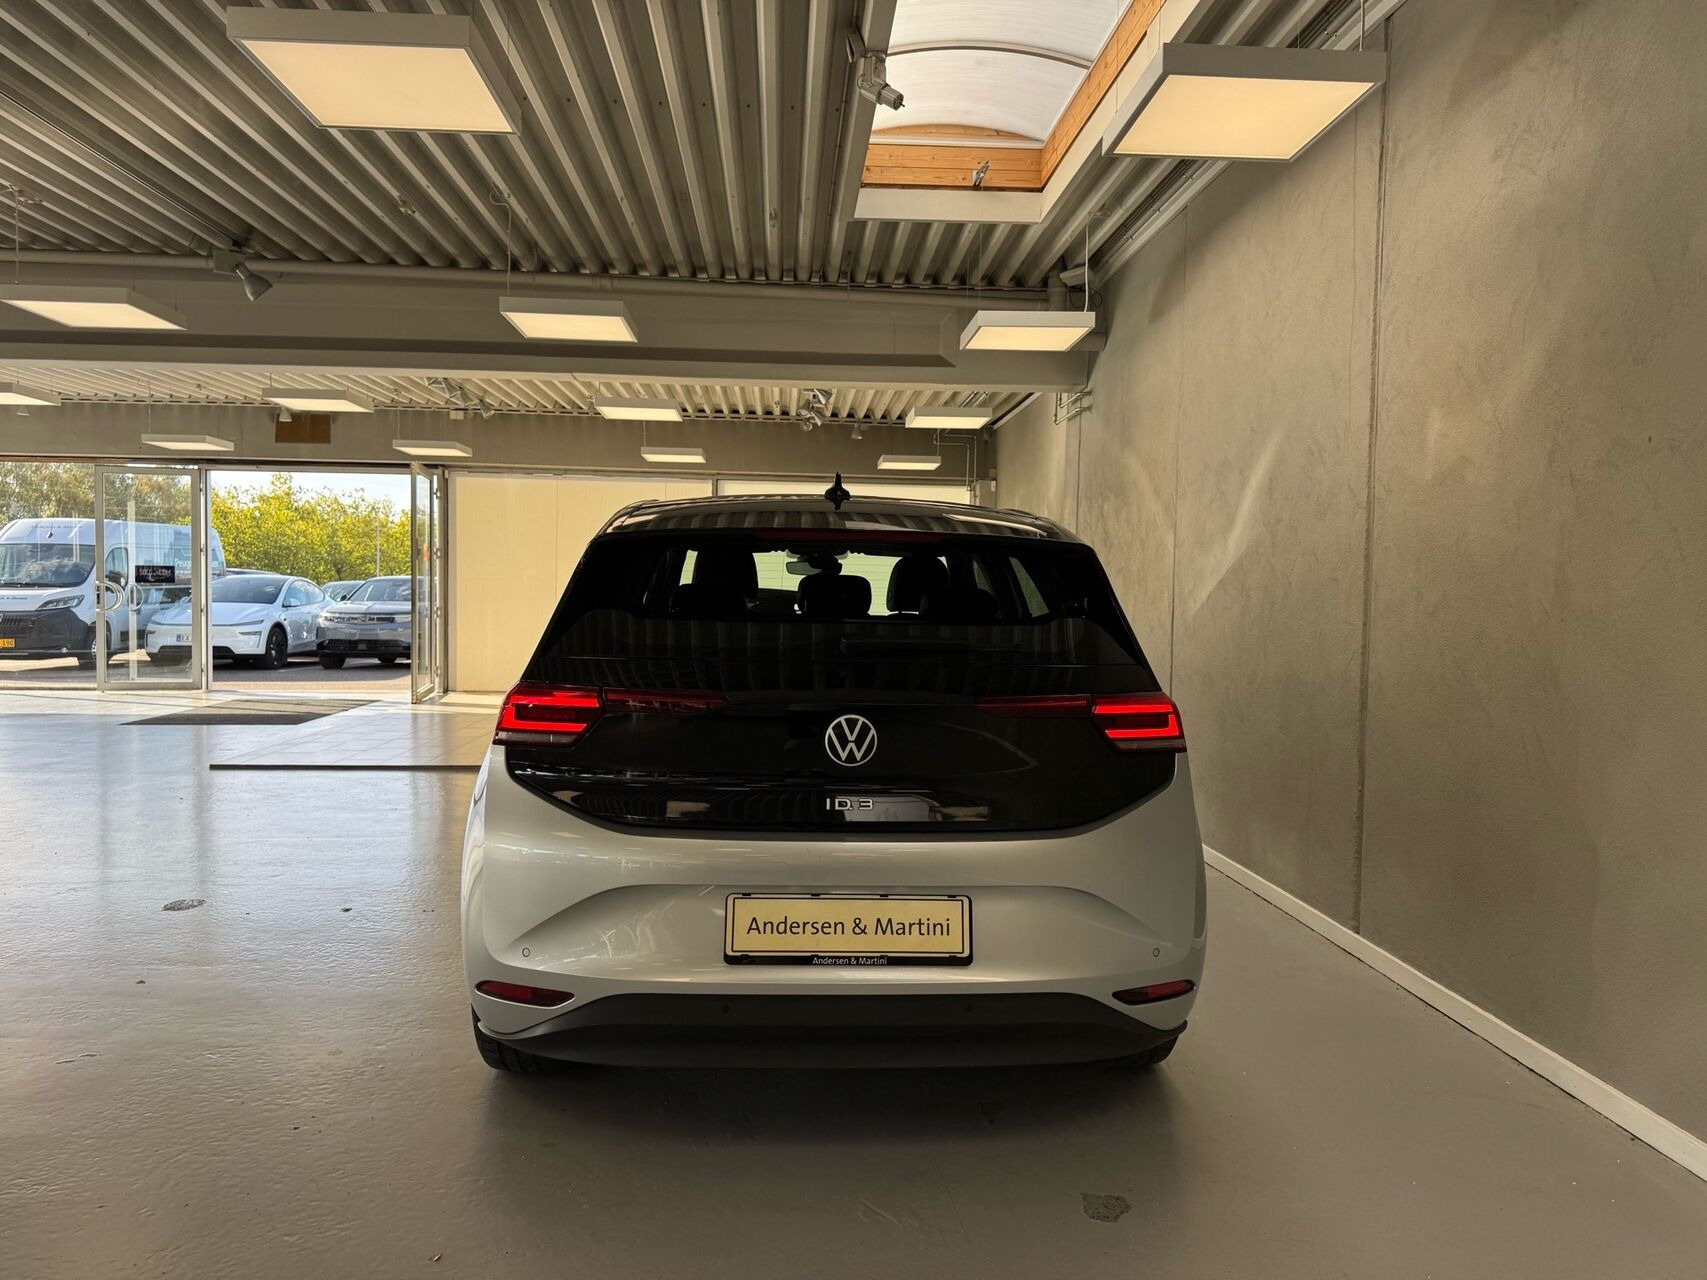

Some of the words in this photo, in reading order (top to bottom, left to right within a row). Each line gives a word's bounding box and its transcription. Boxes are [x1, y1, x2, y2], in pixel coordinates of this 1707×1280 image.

[825, 714, 878, 767] VW
[746, 915, 845, 936] Andersen
[852, 917, 868, 936] &
[874, 917, 951, 937] Martini
[812, 956, 849, 966] Andersen
[850, 957, 857, 966] &
[858, 956, 888, 966] Martini
